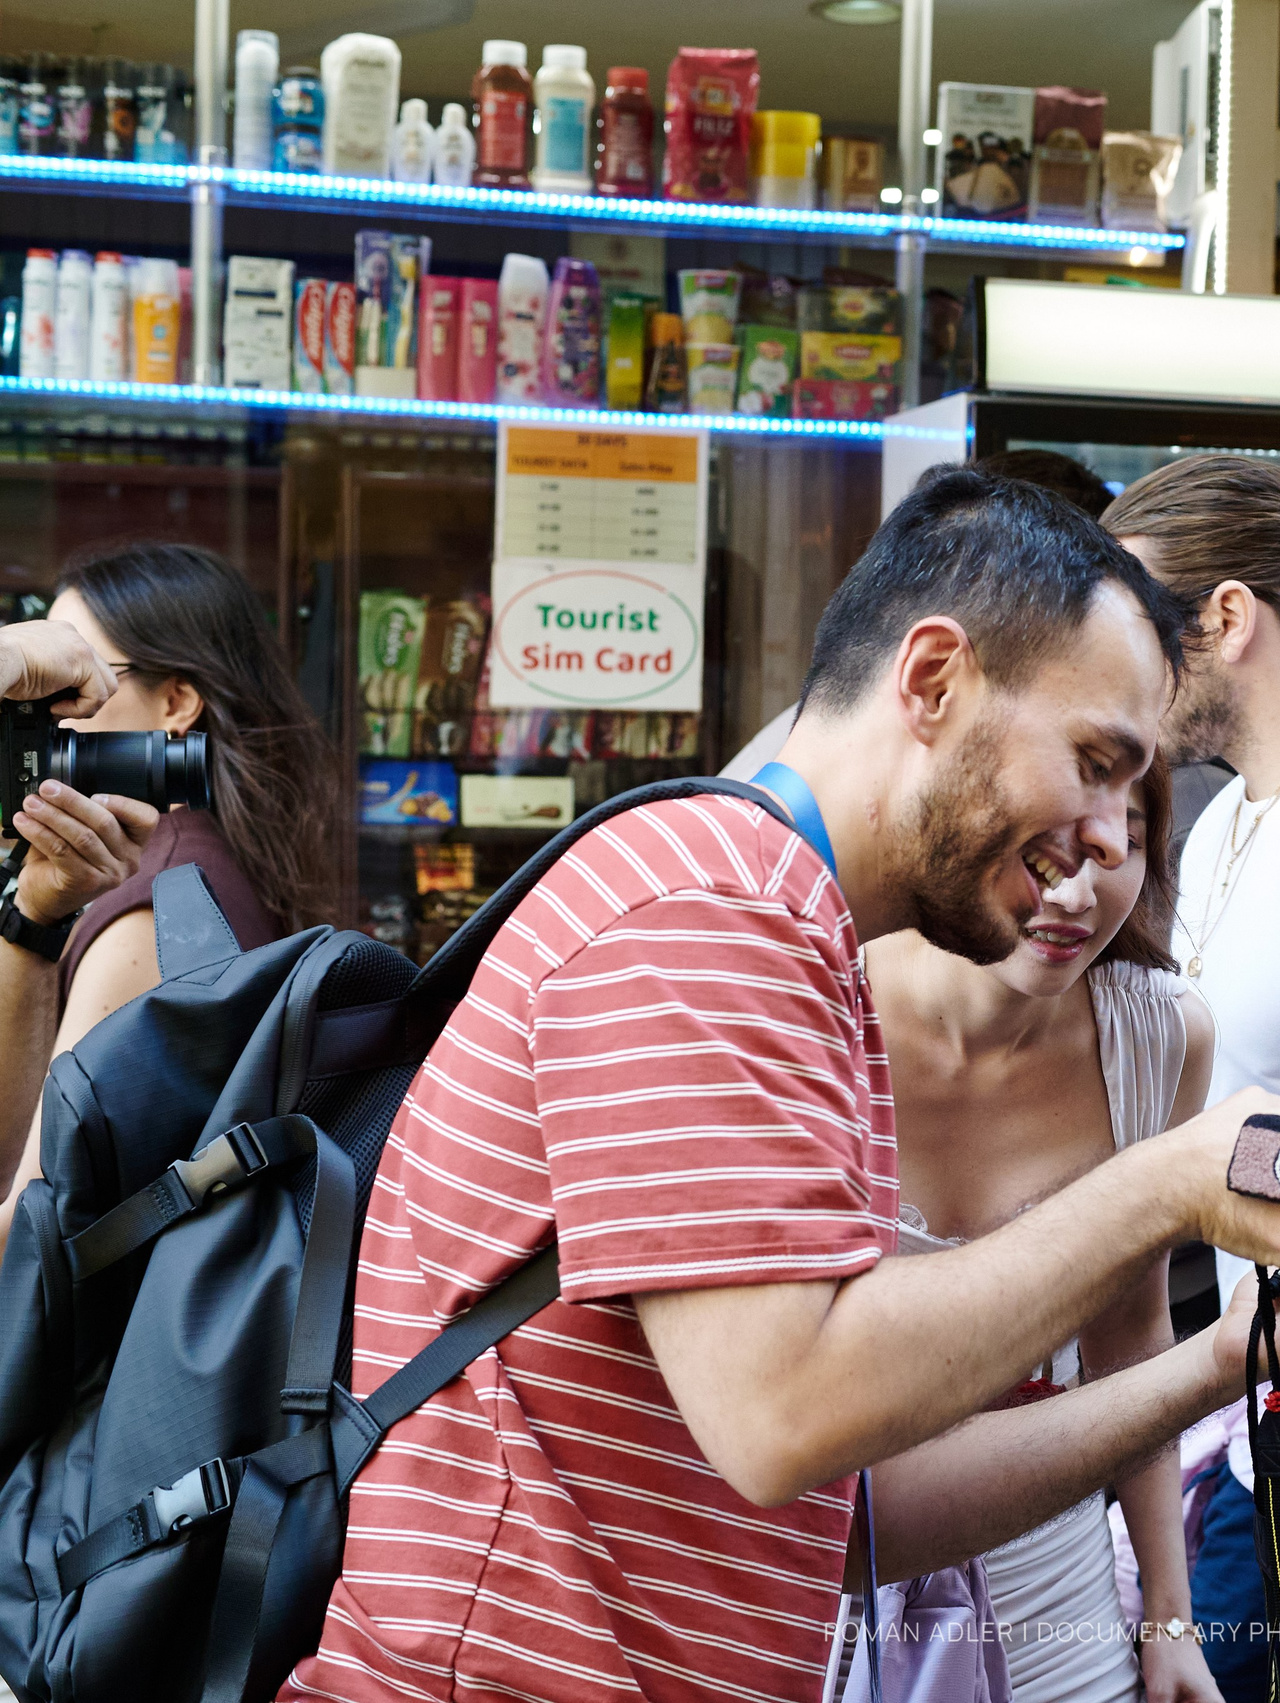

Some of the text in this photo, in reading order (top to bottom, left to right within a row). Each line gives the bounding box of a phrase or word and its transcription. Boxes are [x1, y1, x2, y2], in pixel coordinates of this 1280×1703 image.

[537, 603, 659, 632] Tourist
[522, 642, 673, 674] Sim Card
